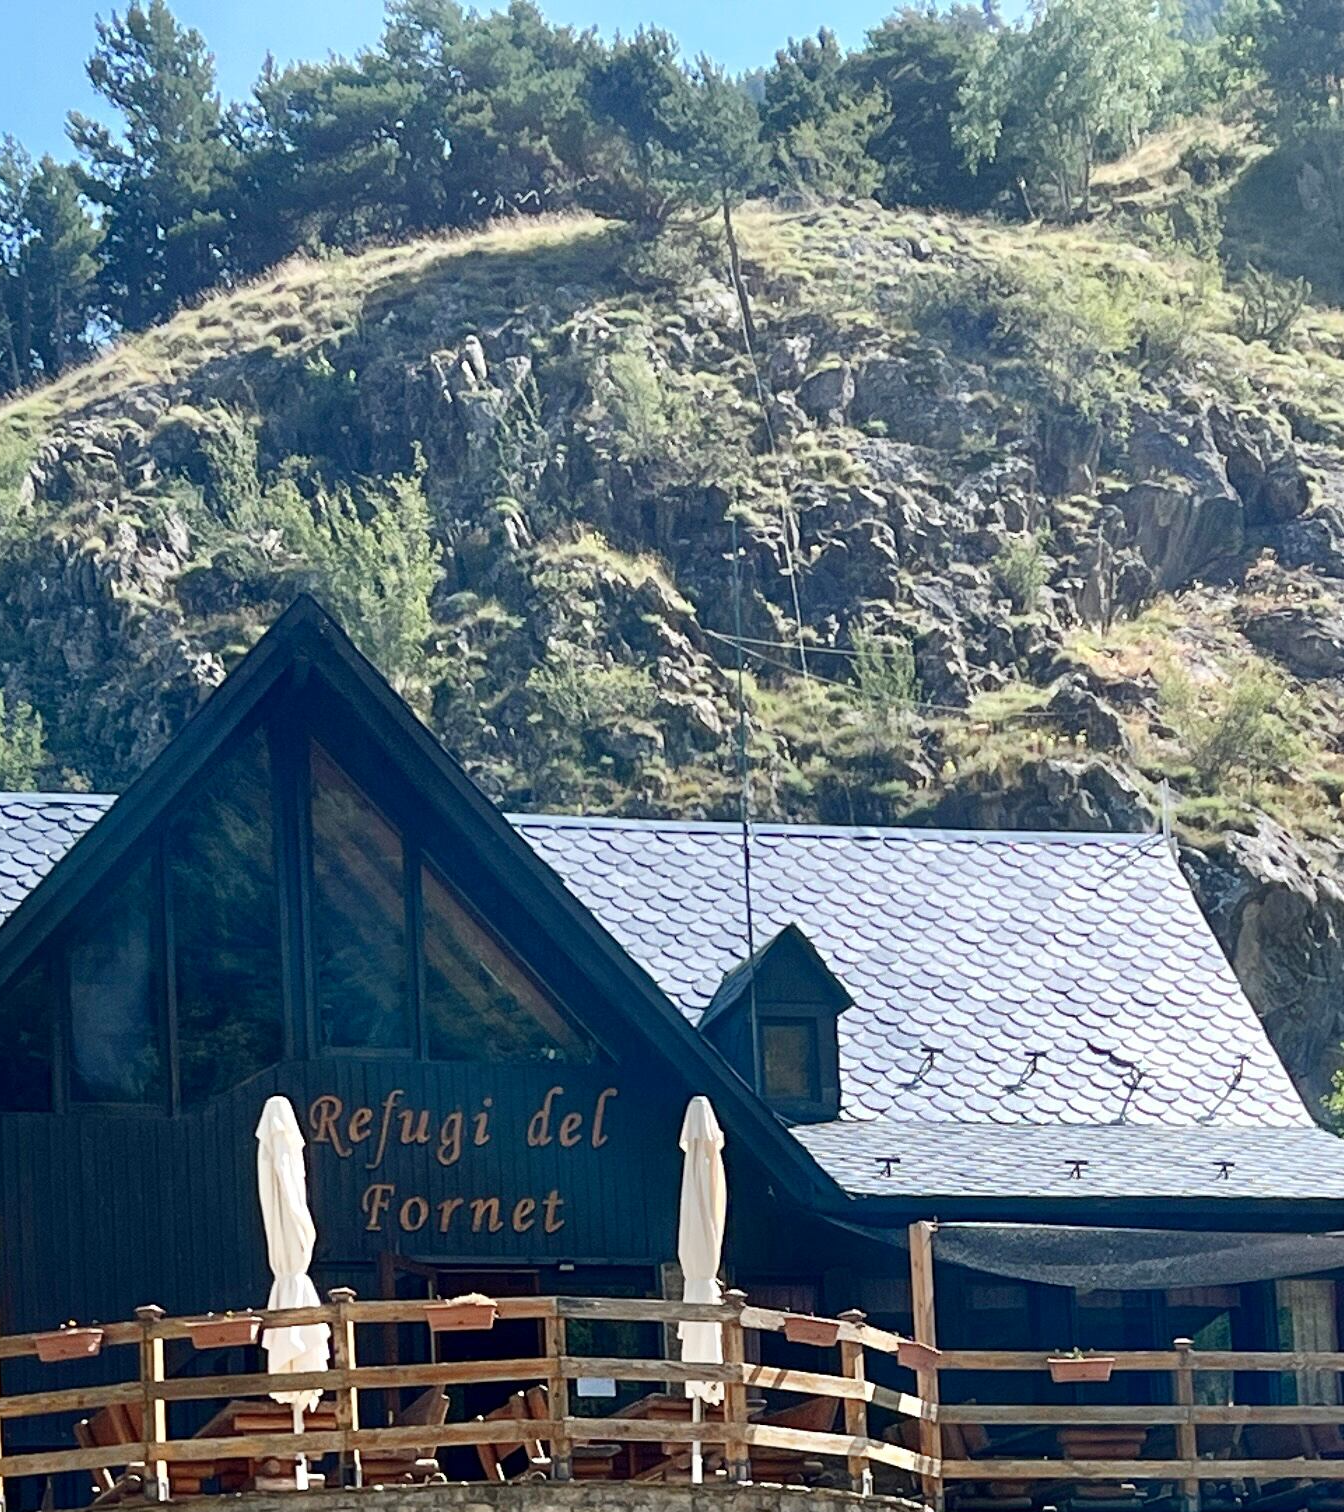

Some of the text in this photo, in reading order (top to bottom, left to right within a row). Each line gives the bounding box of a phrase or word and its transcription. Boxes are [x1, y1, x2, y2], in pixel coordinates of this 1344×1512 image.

[309, 1086, 618, 1169] Refugi del
[362, 1184, 565, 1234] Fornet
